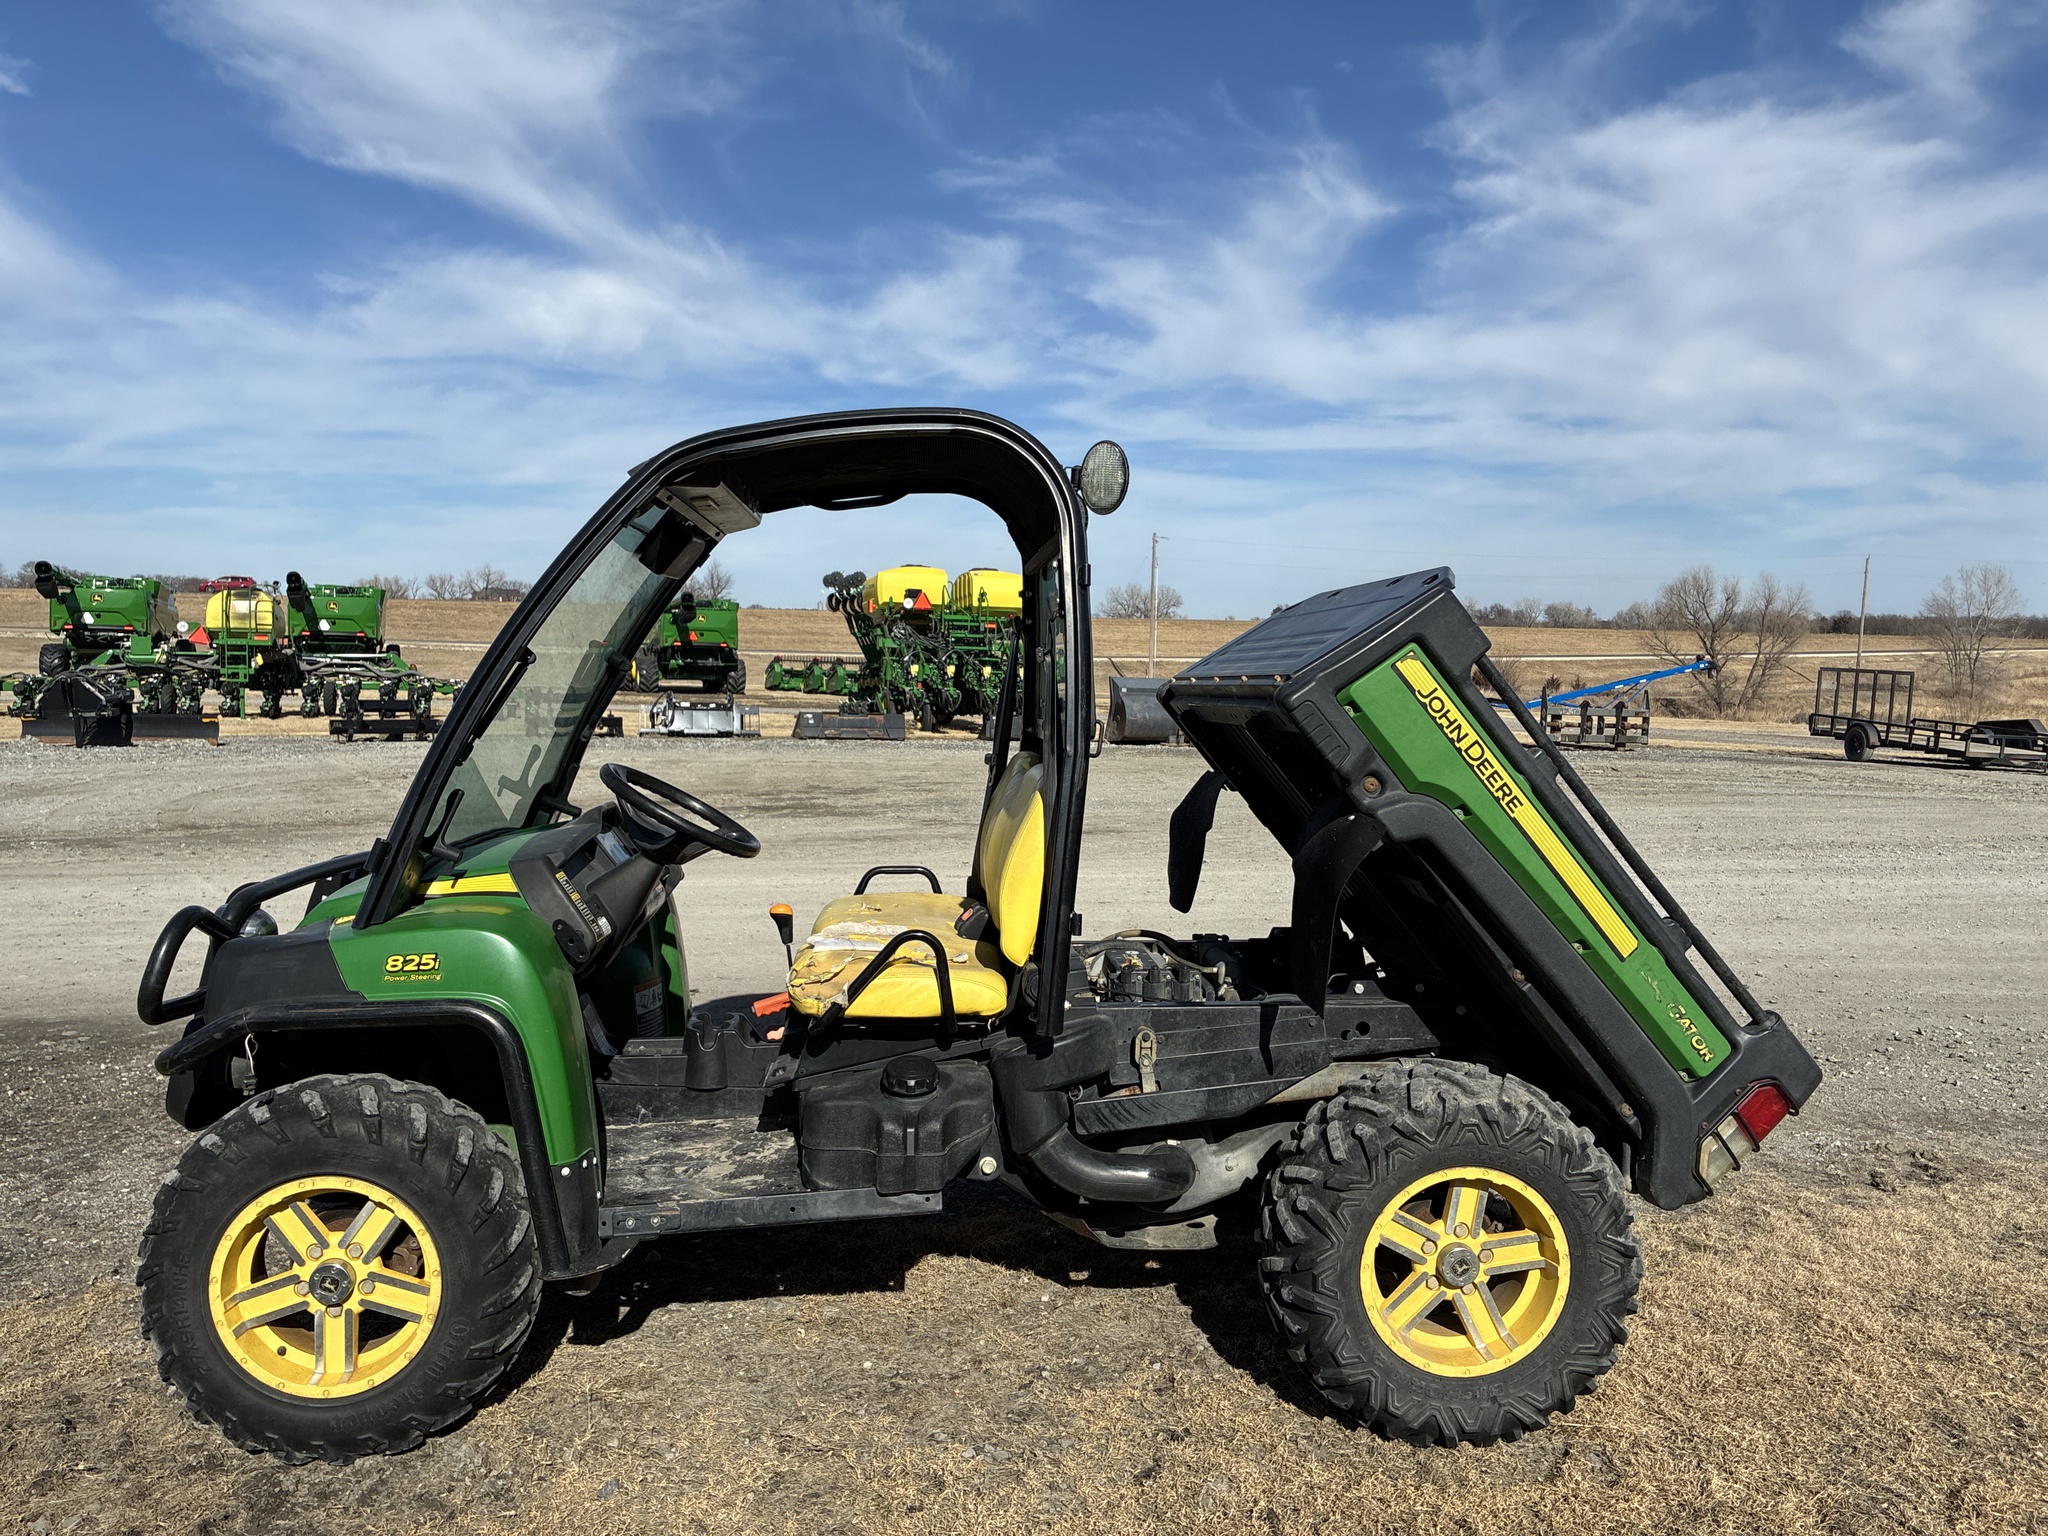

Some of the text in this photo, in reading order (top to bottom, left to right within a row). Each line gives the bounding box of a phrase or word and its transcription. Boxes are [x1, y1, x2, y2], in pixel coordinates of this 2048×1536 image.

[1416, 687, 1524, 815] JOHN DEERE
[385, 953, 440, 972] 825i
[410, 973, 442, 981] Steering
